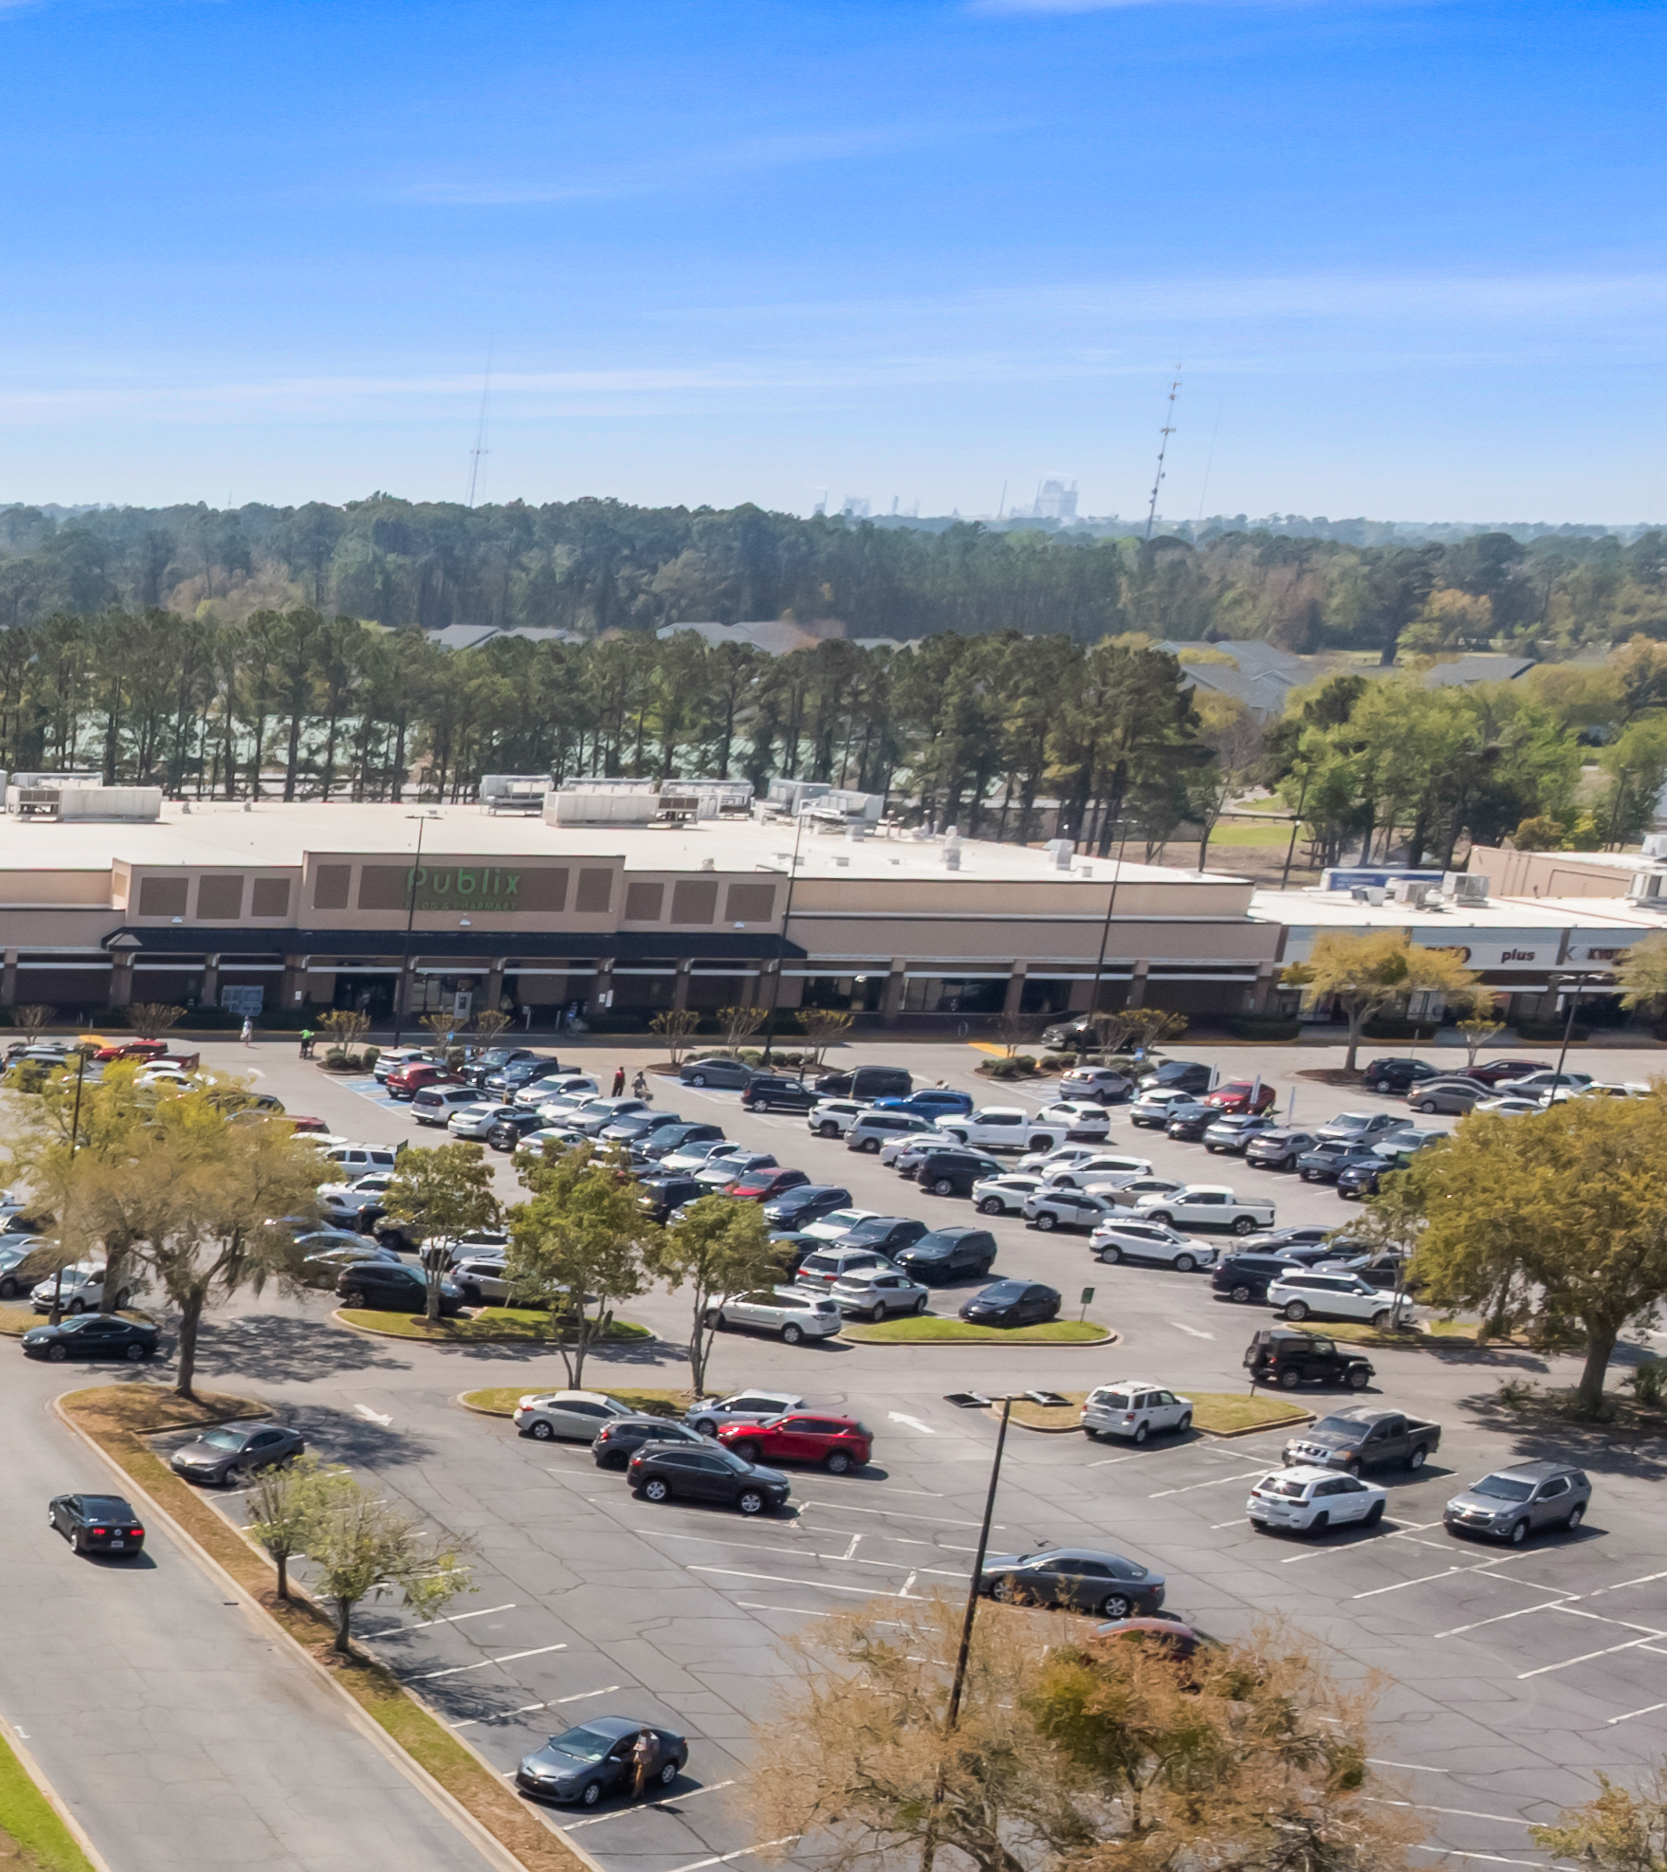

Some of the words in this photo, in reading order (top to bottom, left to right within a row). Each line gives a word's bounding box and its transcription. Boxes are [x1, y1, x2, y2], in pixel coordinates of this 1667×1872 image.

[407, 867, 520, 895] Publix
[454, 902, 517, 911] PHARMACY
[1501, 948, 1535, 964] plus
